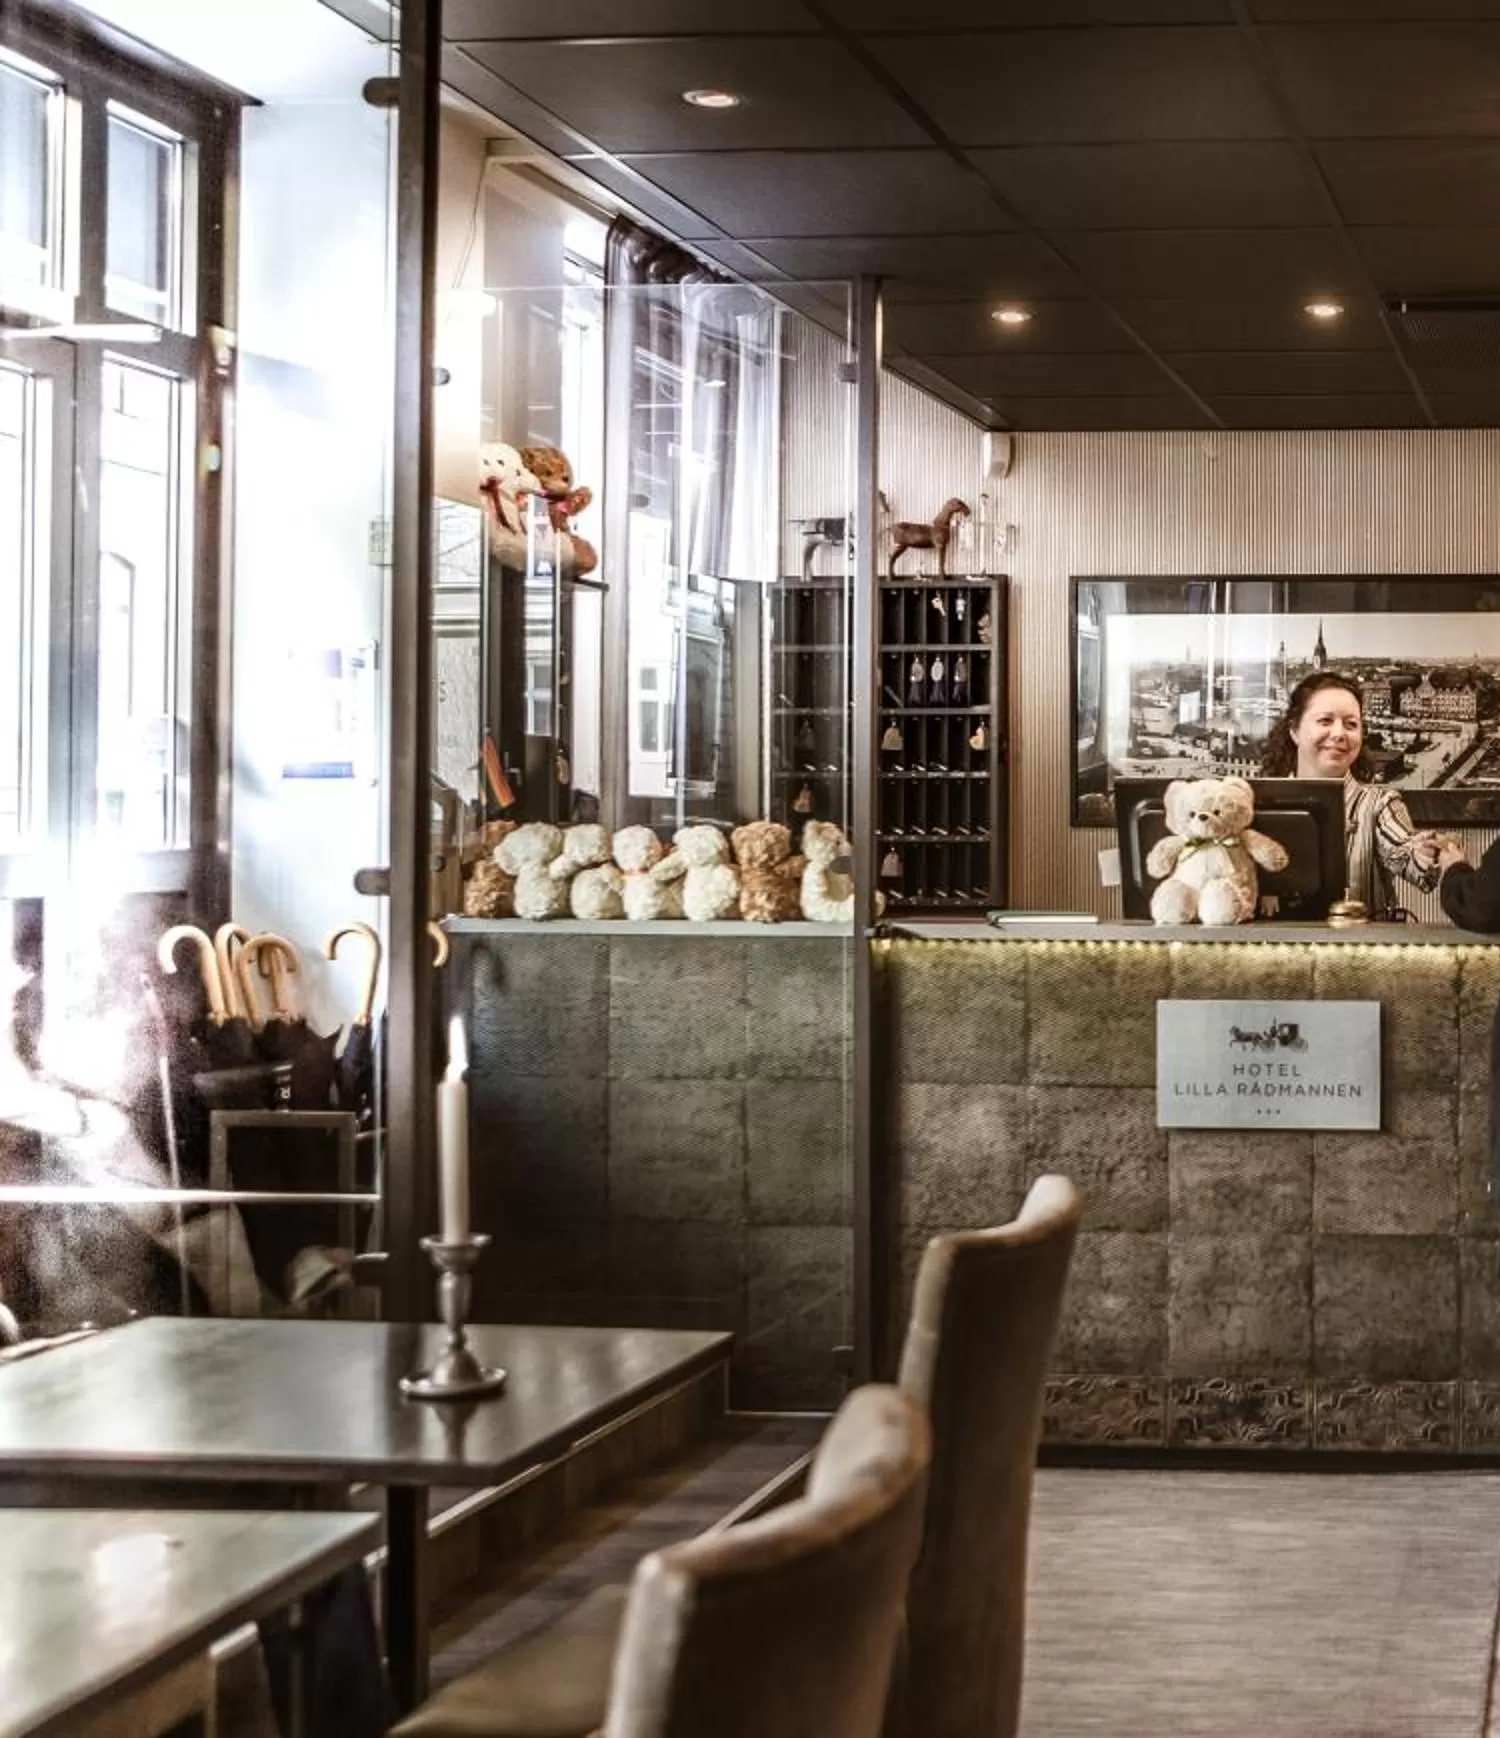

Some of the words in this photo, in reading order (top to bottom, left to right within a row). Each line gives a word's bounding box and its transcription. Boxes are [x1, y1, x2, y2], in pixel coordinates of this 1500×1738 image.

[1232, 1063, 1303, 1078] HOTEL
[1174, 1083, 1229, 1097] LILLA
[1236, 1081, 1362, 1097] RÅDMANNEN
